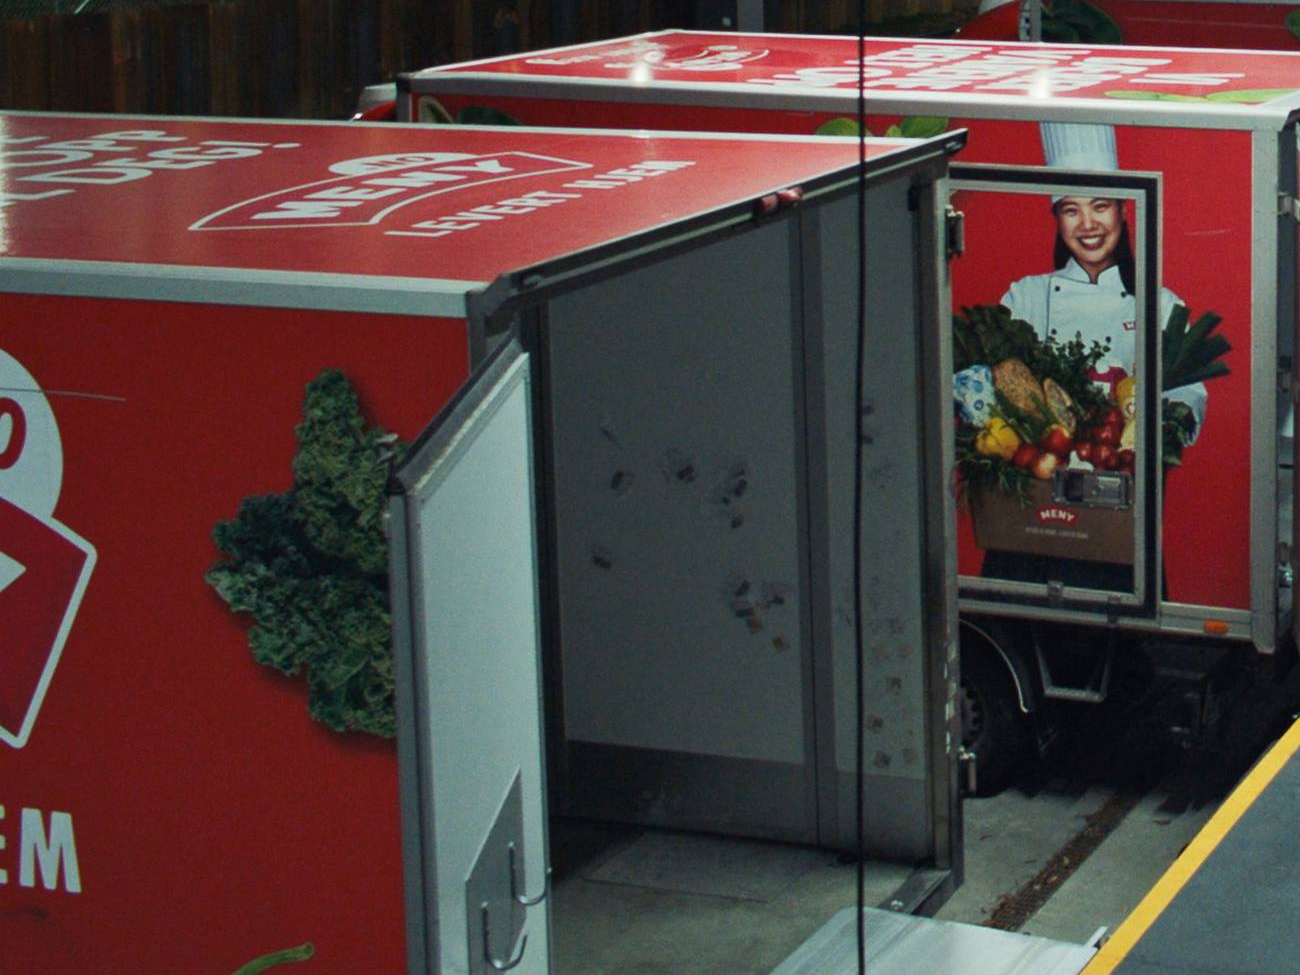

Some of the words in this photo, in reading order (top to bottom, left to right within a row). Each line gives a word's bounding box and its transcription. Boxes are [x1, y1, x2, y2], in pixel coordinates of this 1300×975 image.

[16, 140, 301, 185] DEG!
[252, 158, 515, 221] MENY
[384, 190, 583, 237] LEVERT
[563, 160, 697, 190] HJEM
